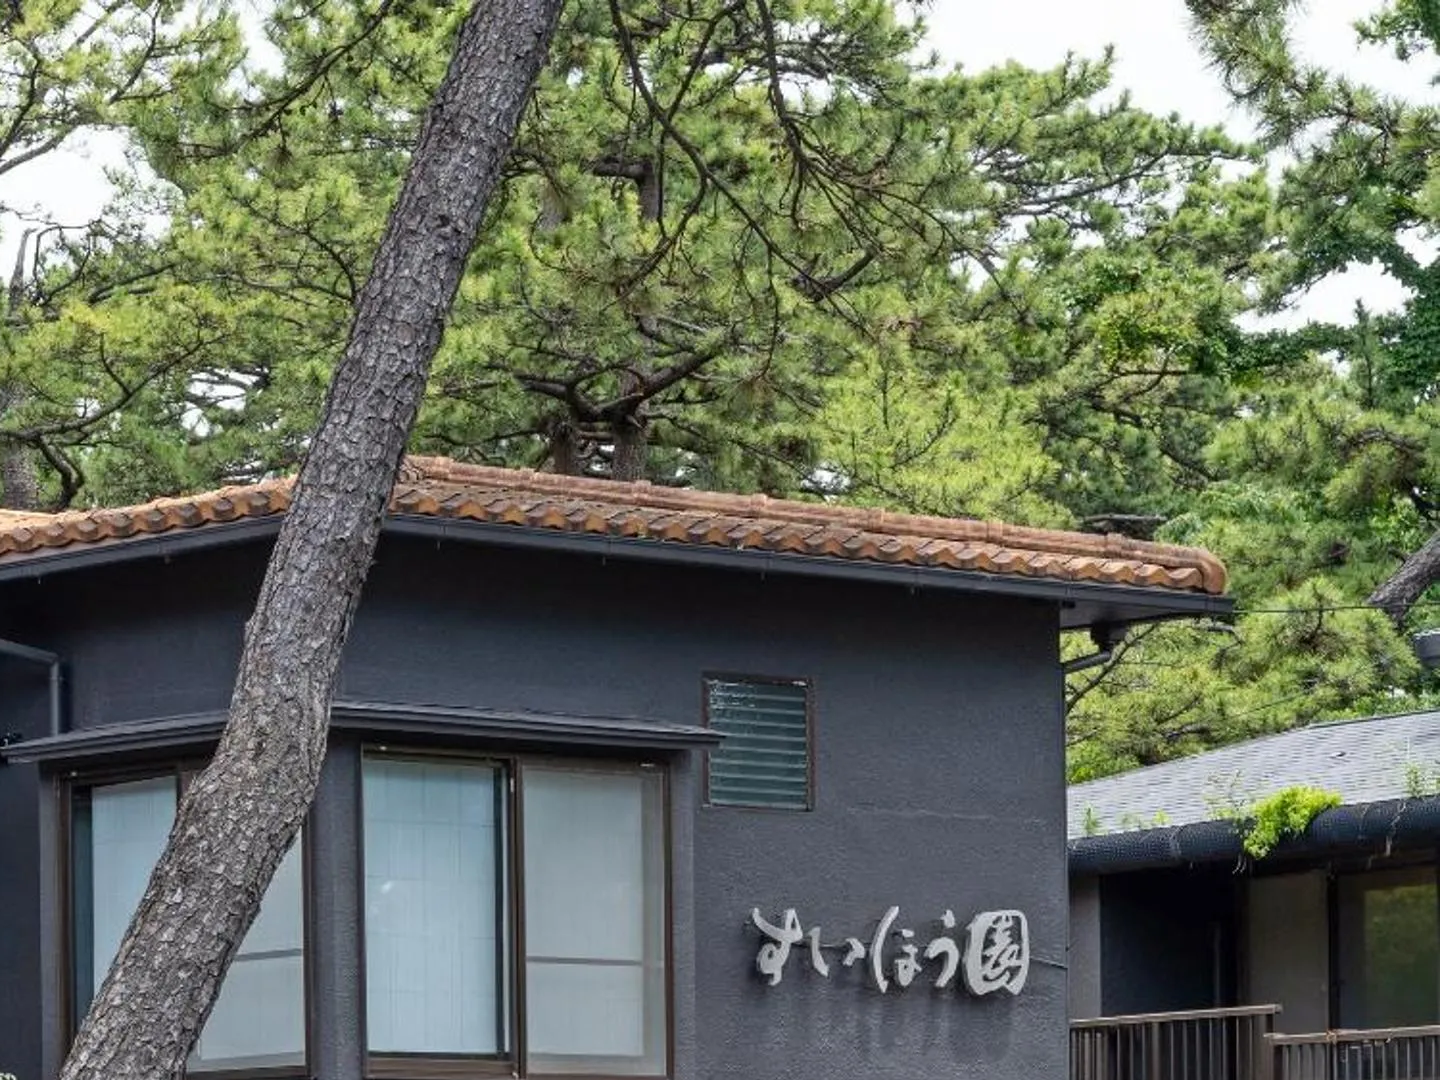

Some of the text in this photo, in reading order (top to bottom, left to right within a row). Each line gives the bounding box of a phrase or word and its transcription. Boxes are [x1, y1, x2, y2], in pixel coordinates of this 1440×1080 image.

[752, 906, 1030, 995] すいほう園
